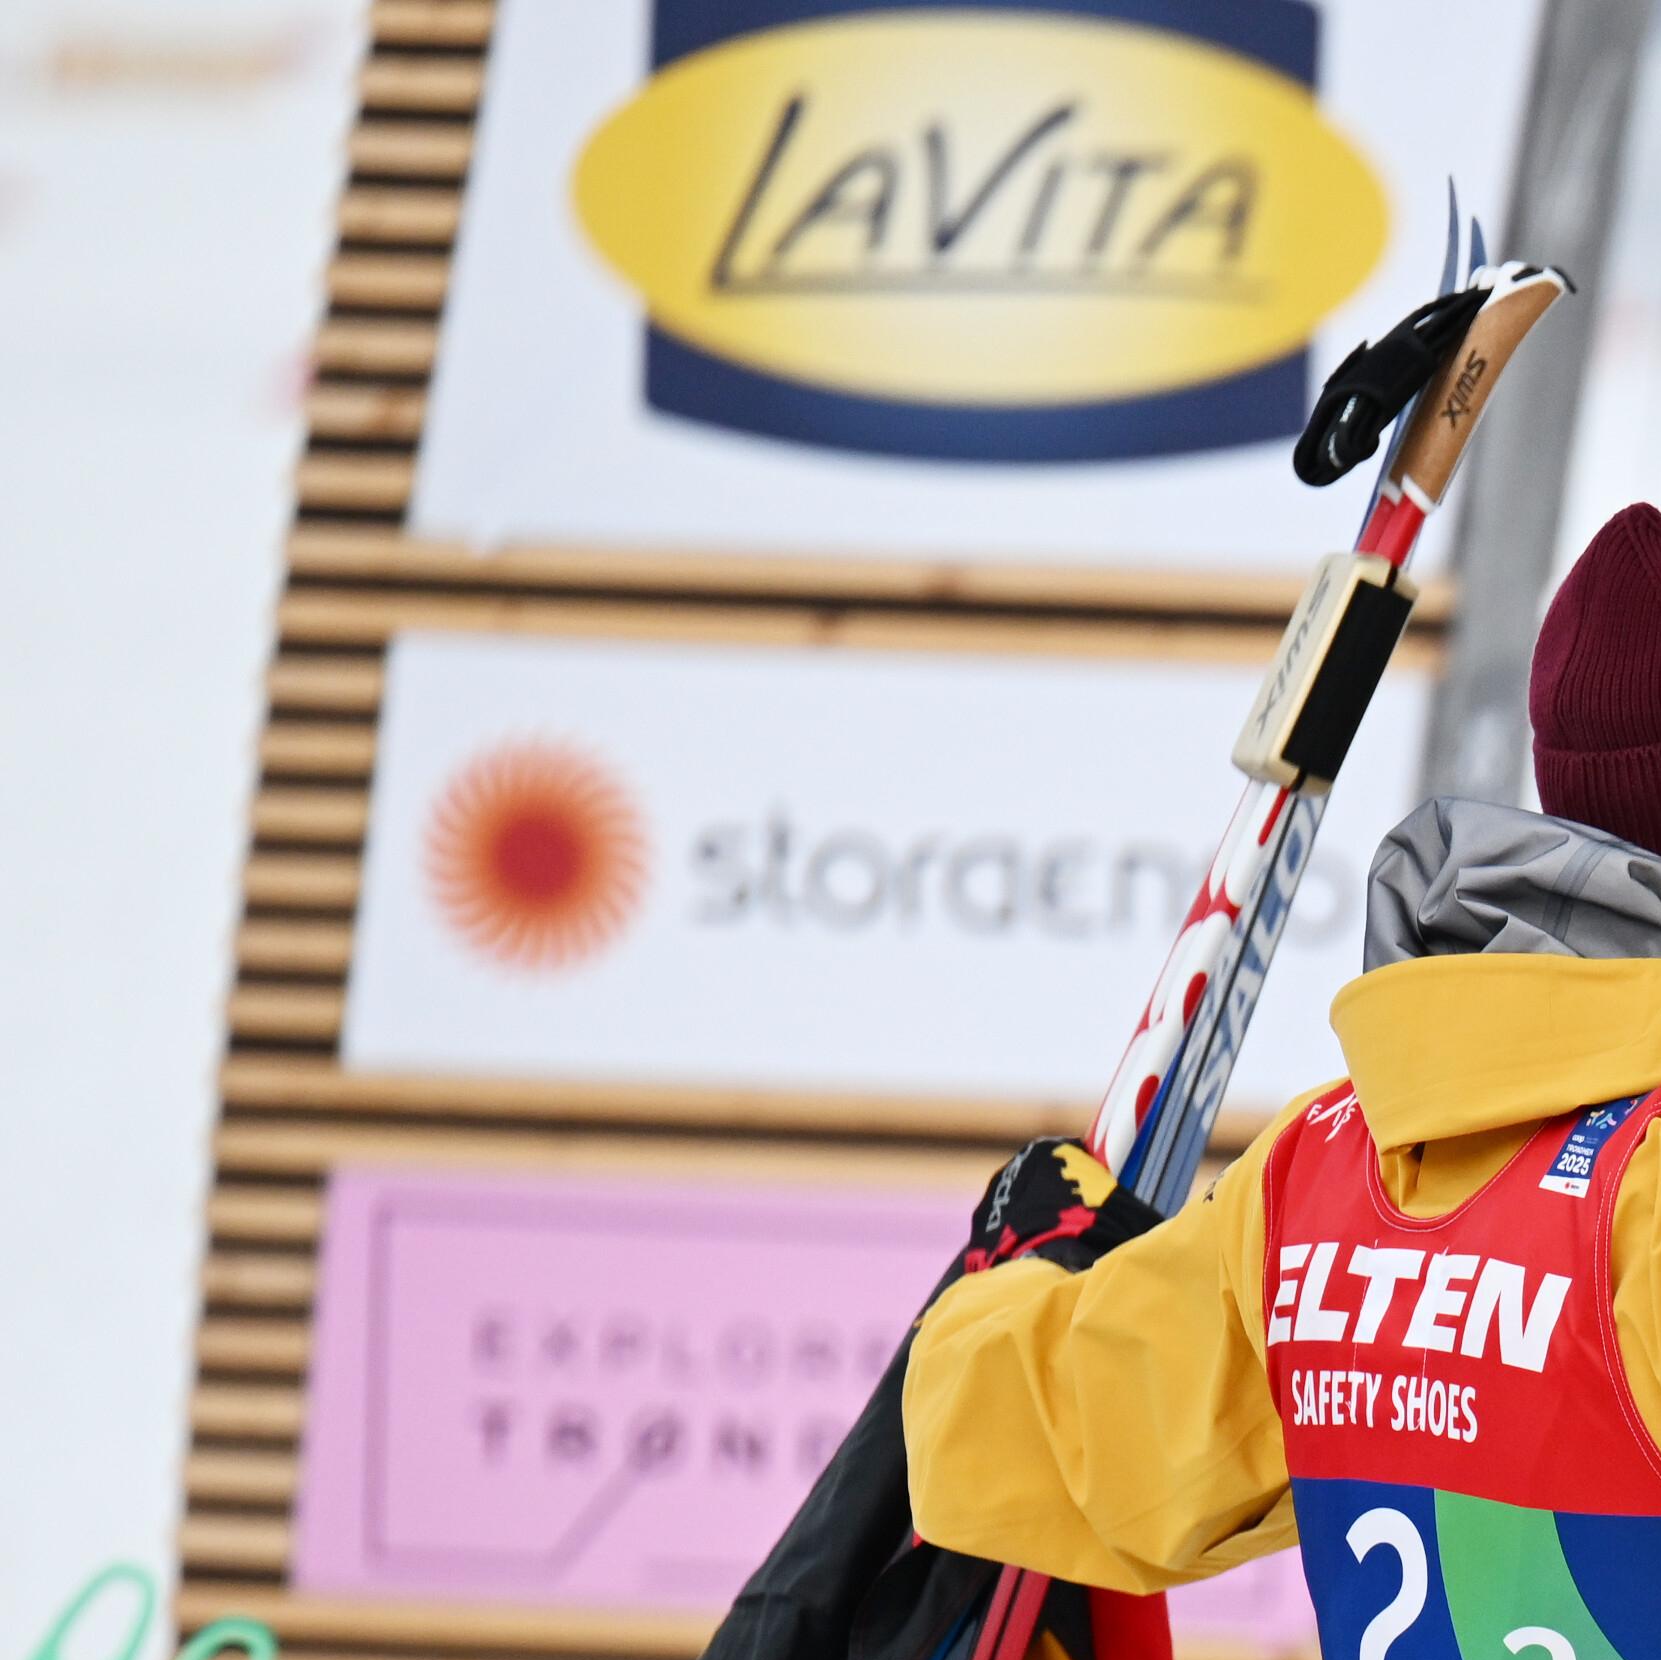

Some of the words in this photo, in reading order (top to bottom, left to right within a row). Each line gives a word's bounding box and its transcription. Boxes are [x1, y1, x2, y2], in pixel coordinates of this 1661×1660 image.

[1557, 1153, 1591, 1175] 2025
[1267, 1240, 1572, 1373] ELTEN
[1291, 1369, 1383, 1431] SAFETY
[1391, 1374, 1479, 1444] SHOES
